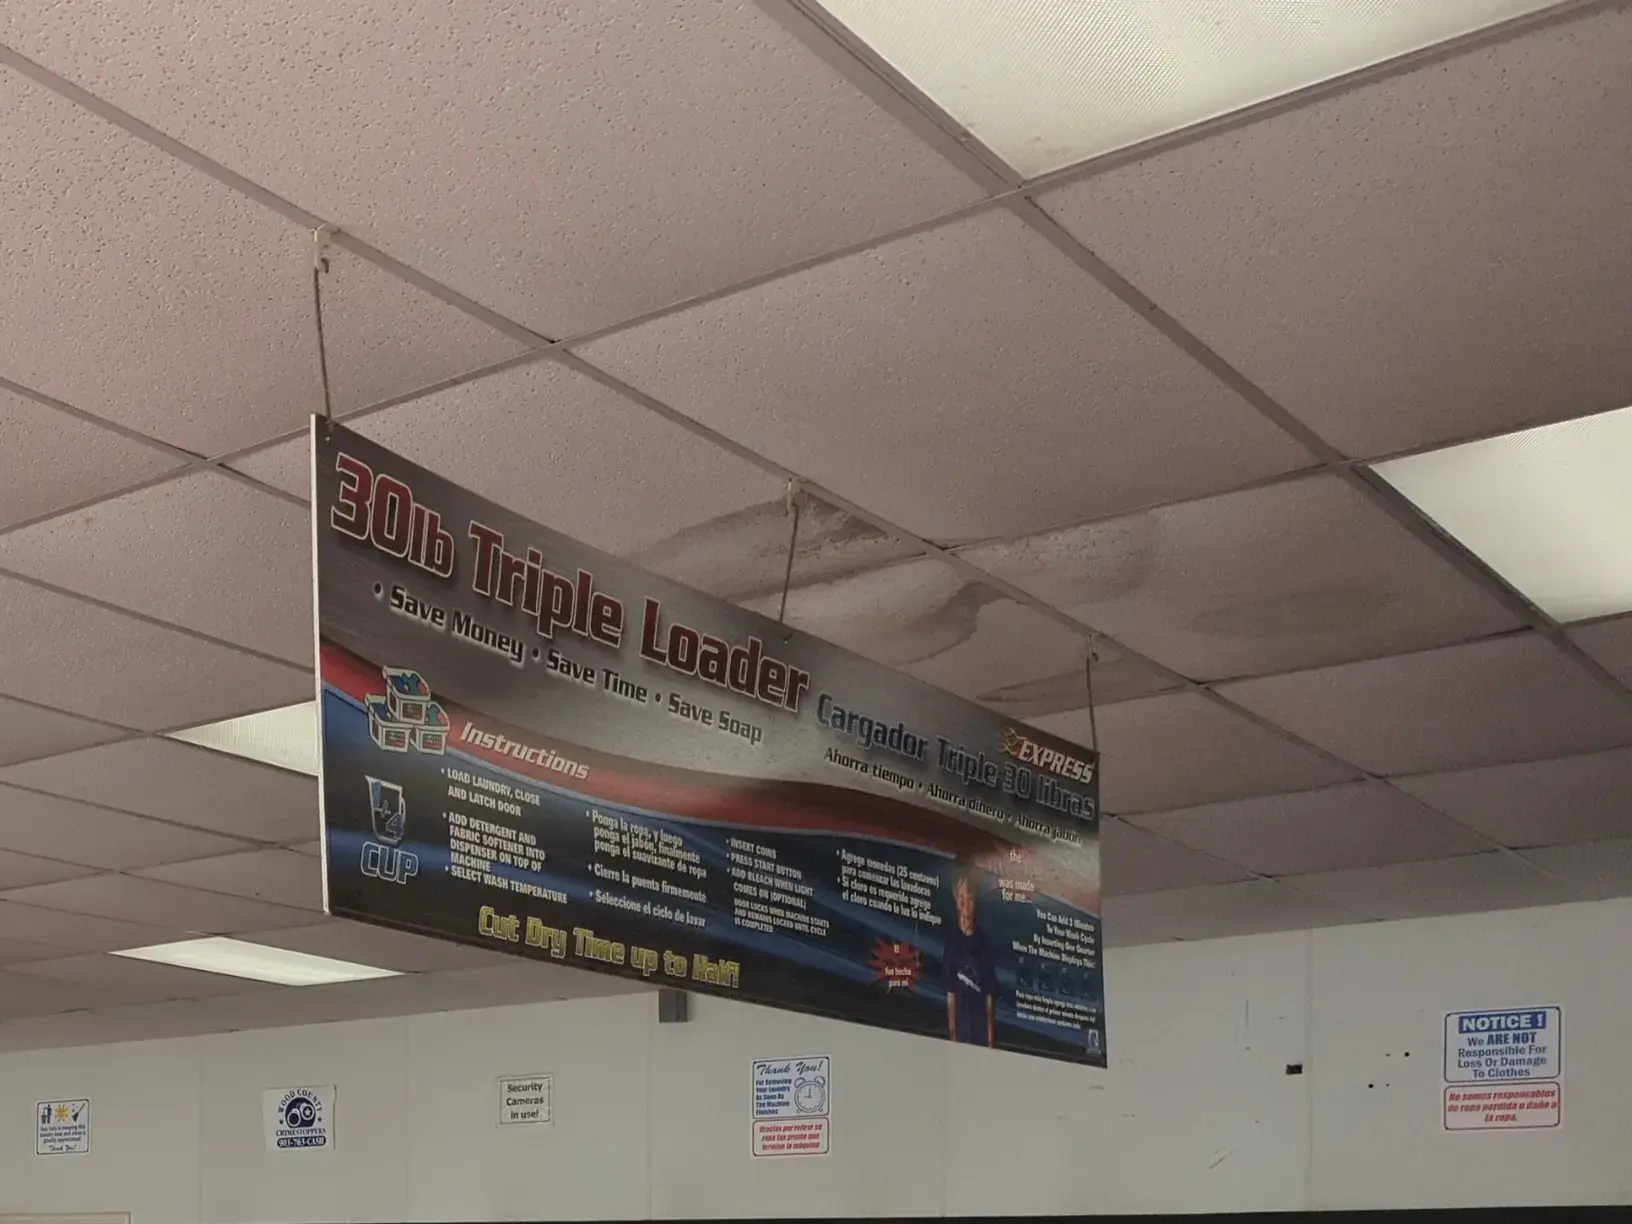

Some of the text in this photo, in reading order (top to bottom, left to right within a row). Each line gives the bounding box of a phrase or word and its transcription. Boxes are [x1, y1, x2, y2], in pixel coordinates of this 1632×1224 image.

[331, 452, 810, 713] 30lb Triple Loader
[390, 584, 762, 745] Save Money Save Time Save Soap
[461, 722, 589, 780] Instructions
[817, 693, 1096, 820] Cargador Triple 30 libras
[1019, 742, 1094, 784] EXPRESS
[448, 768, 540, 805] LOAD LAUNDRY, CLOSE
[448, 787, 521, 816] AND LATCH DOOR
[824, 747, 1051, 834] Ahorra tiempo Ahorra dinero Ahorra
[449, 812, 536, 845] ADD DETERGENT AND
[450, 826, 545, 861] FABRIC SOFTENER INTO
[361, 841, 418, 885] CUP
[450, 839, 542, 872] DISPENSER ON TOP OF
[451, 852, 491, 873] MACHINE
[730, 838, 777, 860] INSERT COINS
[730, 852, 802, 880] PRESS START BUTTON
[451, 867, 568, 904] SELECT WASH TEMPERATURE
[731, 867, 813, 897] ADD BLEACH WHEN LIGHT
[478, 905, 741, 988] Cut Dry Time up to Half!
[1462, 1014, 1532, 1031] NOTICE
[1458, 1044, 1547, 1058] Responsible For
[1467, 1032, 1537, 1046] We ARE NOT
[757, 1060, 823, 1076] Thank You!
[1458, 1056, 1547, 1068] Loss Or Damage
[1473, 1067, 1530, 1078] To Clothes
[278, 1089, 322, 1113] WOOD COUNTY
[506, 1096, 544, 1106] Cameras
[507, 1082, 544, 1094] Security
